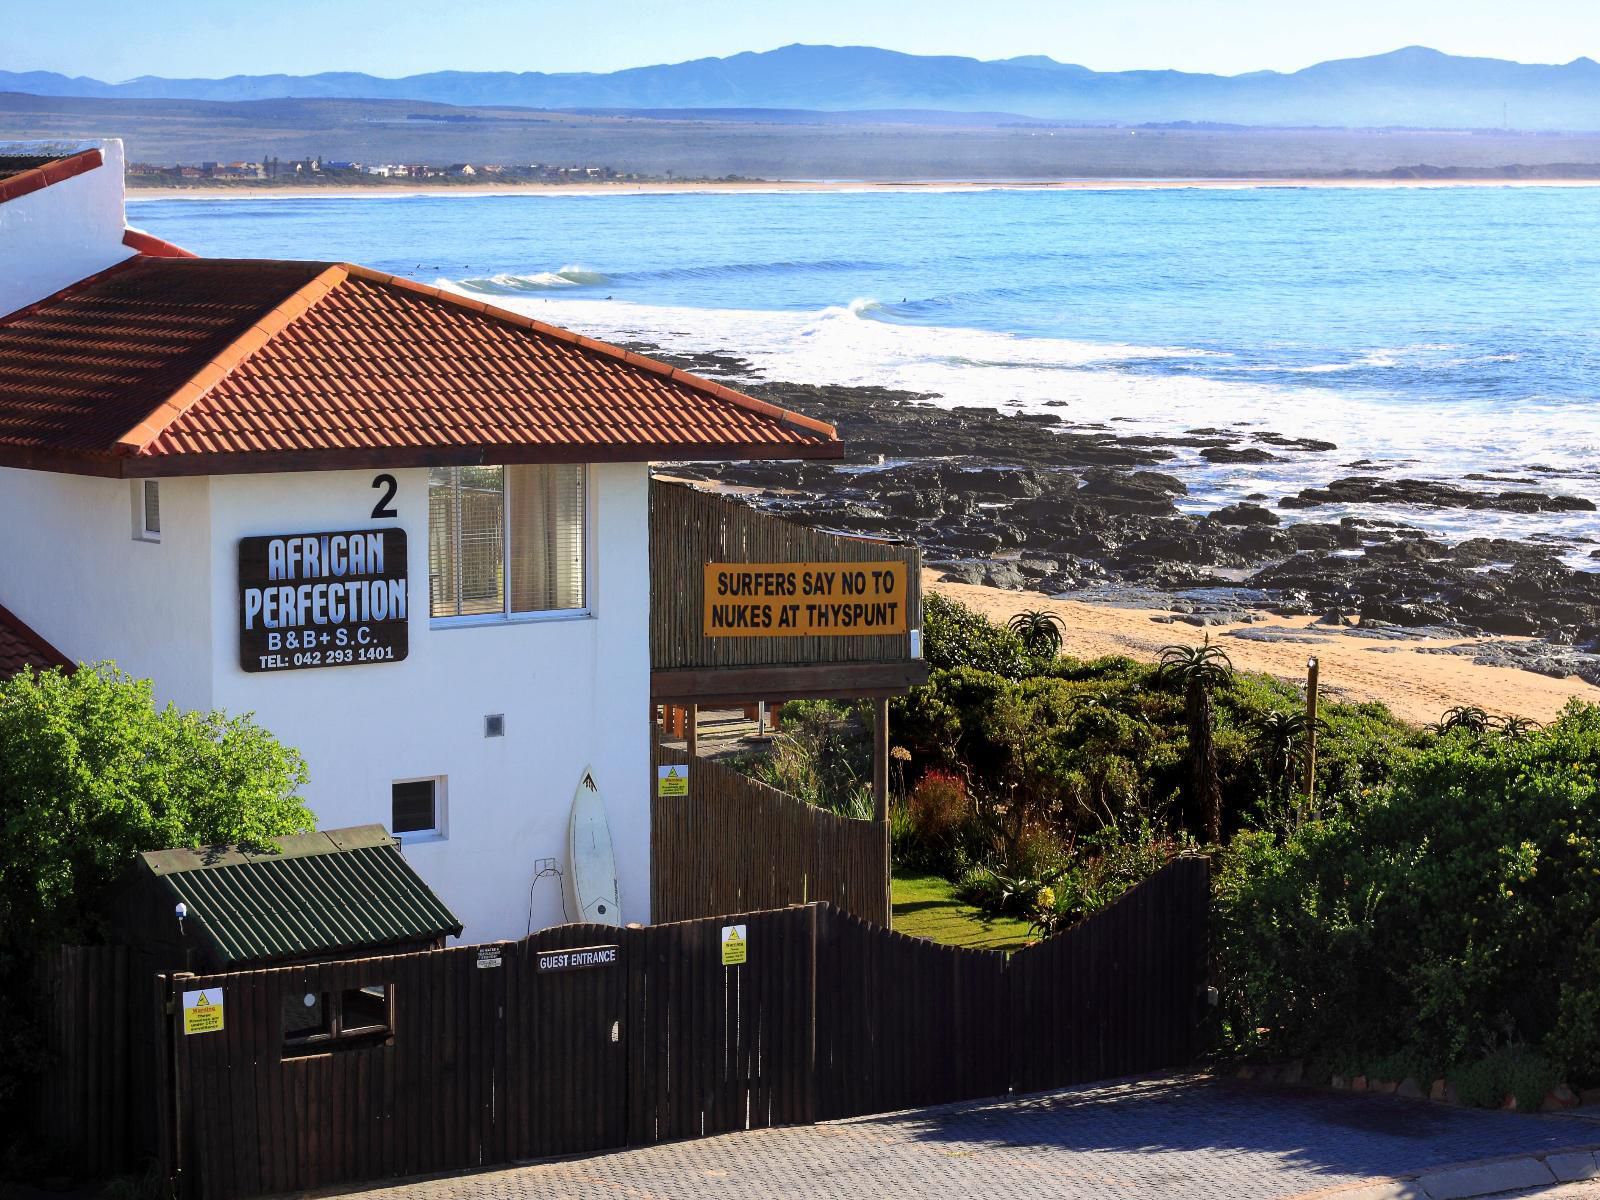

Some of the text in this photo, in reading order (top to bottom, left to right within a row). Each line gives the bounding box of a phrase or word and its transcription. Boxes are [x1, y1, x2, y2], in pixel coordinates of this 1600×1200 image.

[371, 474, 398, 518] 2
[268, 533, 384, 580] AFRICAN
[717, 570, 894, 596] SURFERS SAY NO TO
[245, 579, 406, 629] PERFECTION
[712, 602, 898, 628] NUKES AT THYSPUNT
[259, 646, 394, 669] TEL: 042 293 1401
[540, 949, 616, 969] GUEST ENTRANCE
